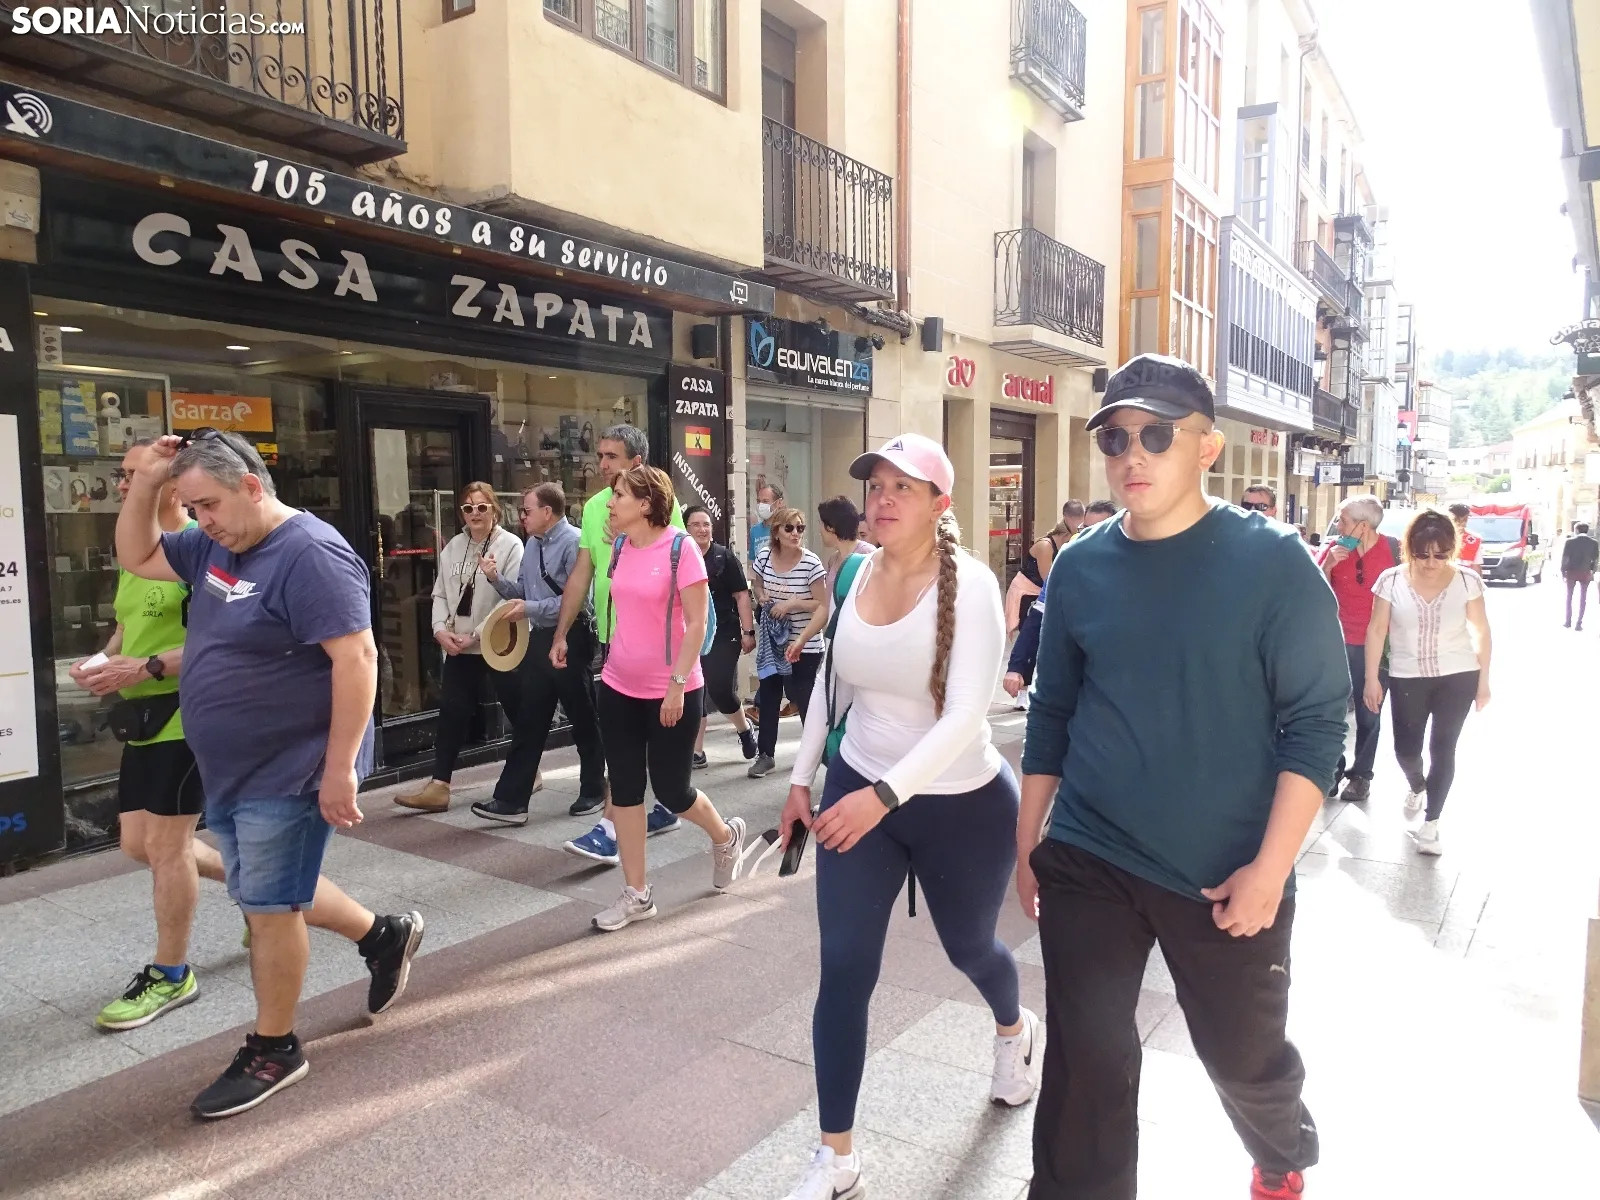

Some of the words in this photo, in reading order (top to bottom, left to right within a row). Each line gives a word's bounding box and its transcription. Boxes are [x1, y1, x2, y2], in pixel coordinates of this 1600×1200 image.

[251, 160, 327, 205] 105
[351, 191, 452, 235] años
[471, 221, 492, 246] a
[509, 226, 546, 259] su
[560, 240, 668, 286] servicio
[132, 212, 378, 302] CASA
[450, 275, 653, 348] ZAPATA
[681, 376, 714, 394] CASA
[807, 375, 814, 383] La
[852, 383, 870, 392] perfume
[1001, 372, 1054, 405] arenal
[171, 399, 232, 421] Garza
[675, 399, 719, 417] ZAPATA
[672, 451, 722, 521] INSTALACIÓN:
[231, 579, 257, 596] NIKE
[142, 610, 164, 618] SORIA
